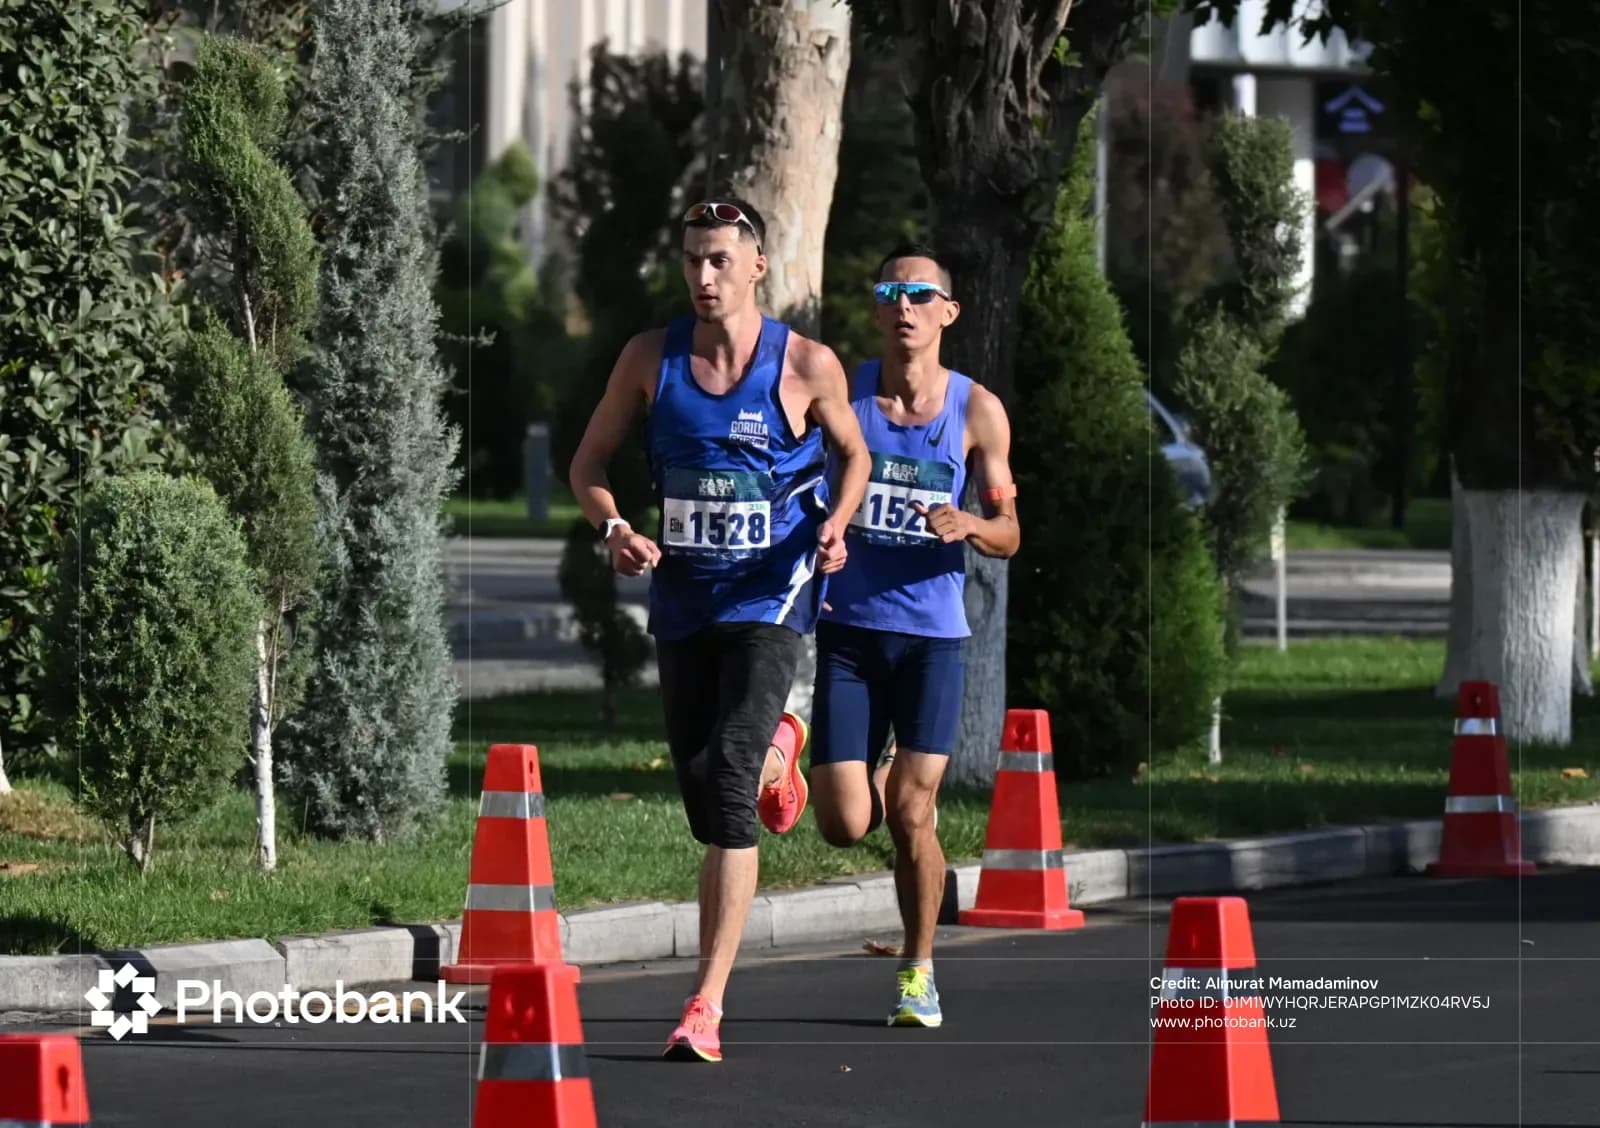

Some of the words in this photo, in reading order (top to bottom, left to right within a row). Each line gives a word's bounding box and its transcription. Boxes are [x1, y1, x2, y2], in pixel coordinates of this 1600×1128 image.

[731, 420, 768, 436] GORILLA
[884, 461, 919, 476] TASH
[699, 478, 735, 488] TASH
[869, 494, 941, 533] 152
[690, 511, 766, 546] 1528
